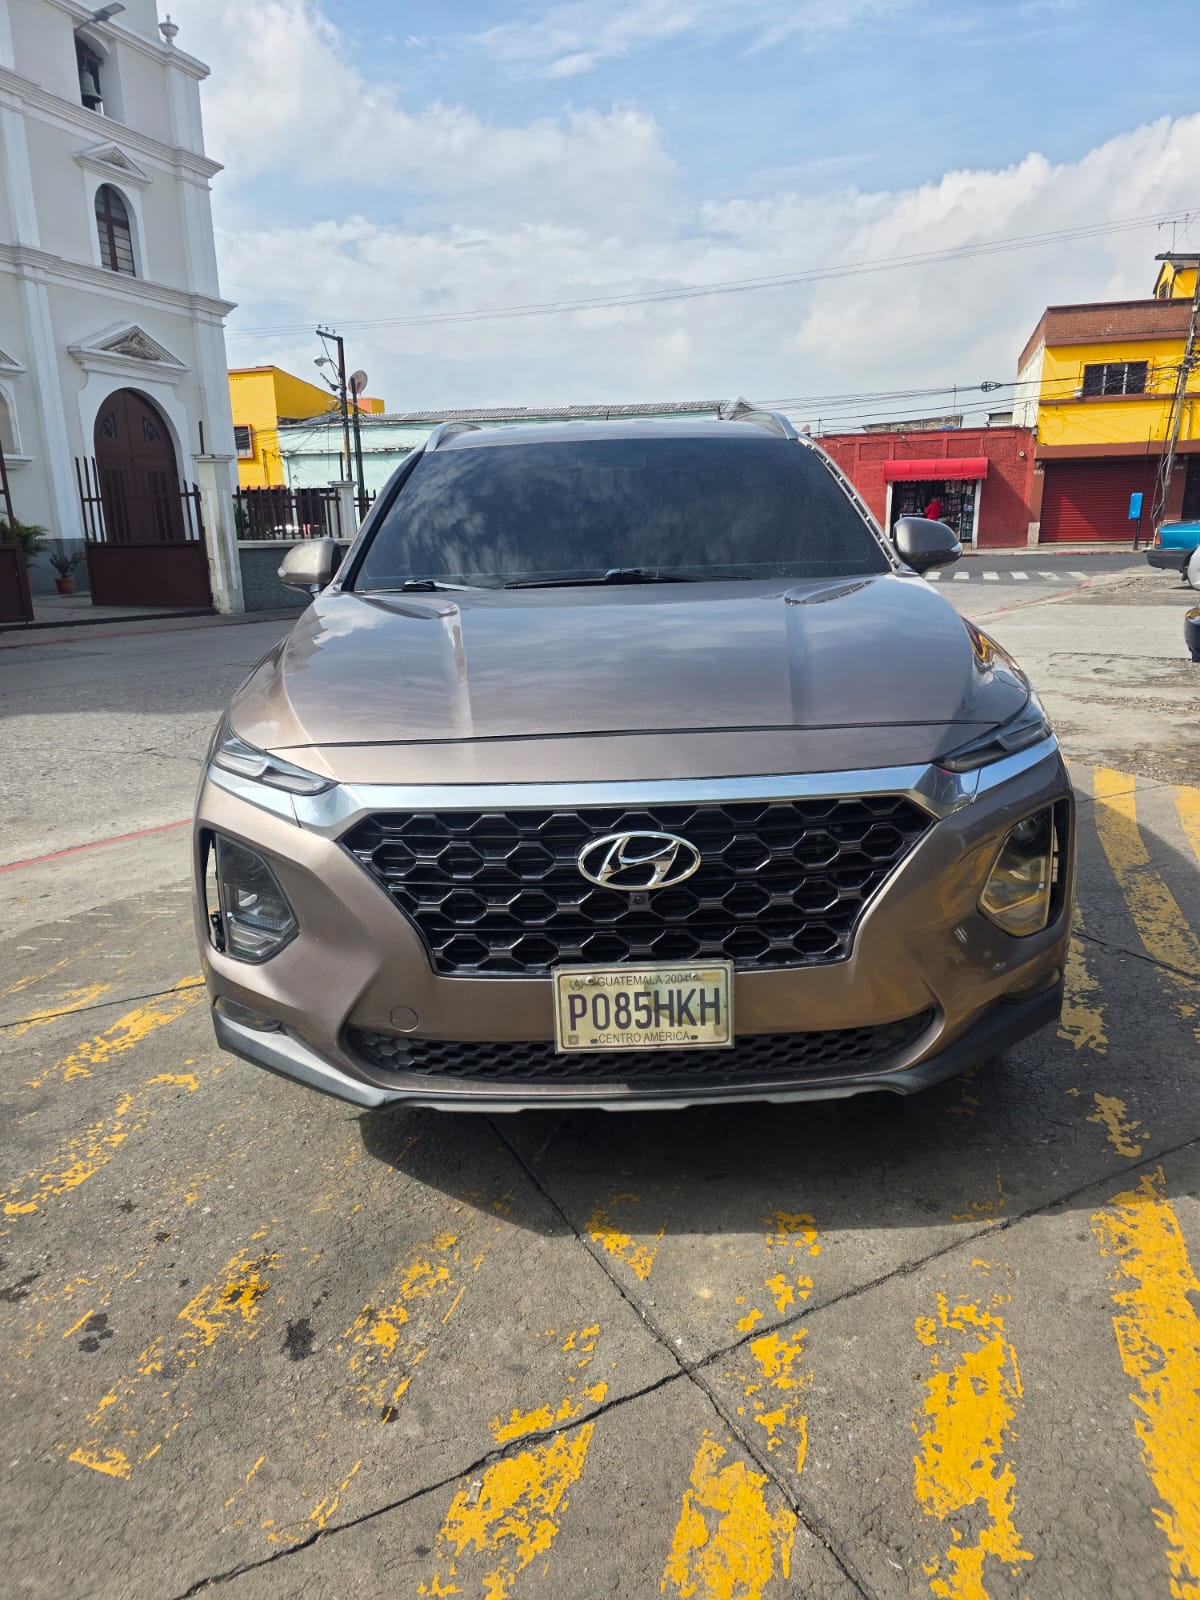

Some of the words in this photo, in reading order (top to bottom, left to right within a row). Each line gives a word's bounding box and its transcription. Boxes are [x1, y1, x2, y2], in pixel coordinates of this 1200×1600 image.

[598, 975, 663, 987] GUATEMALA
[665, 973, 689, 984] 2004
[567, 988, 720, 1031] P085HKH
[598, 1032, 641, 1043] CENTRO
